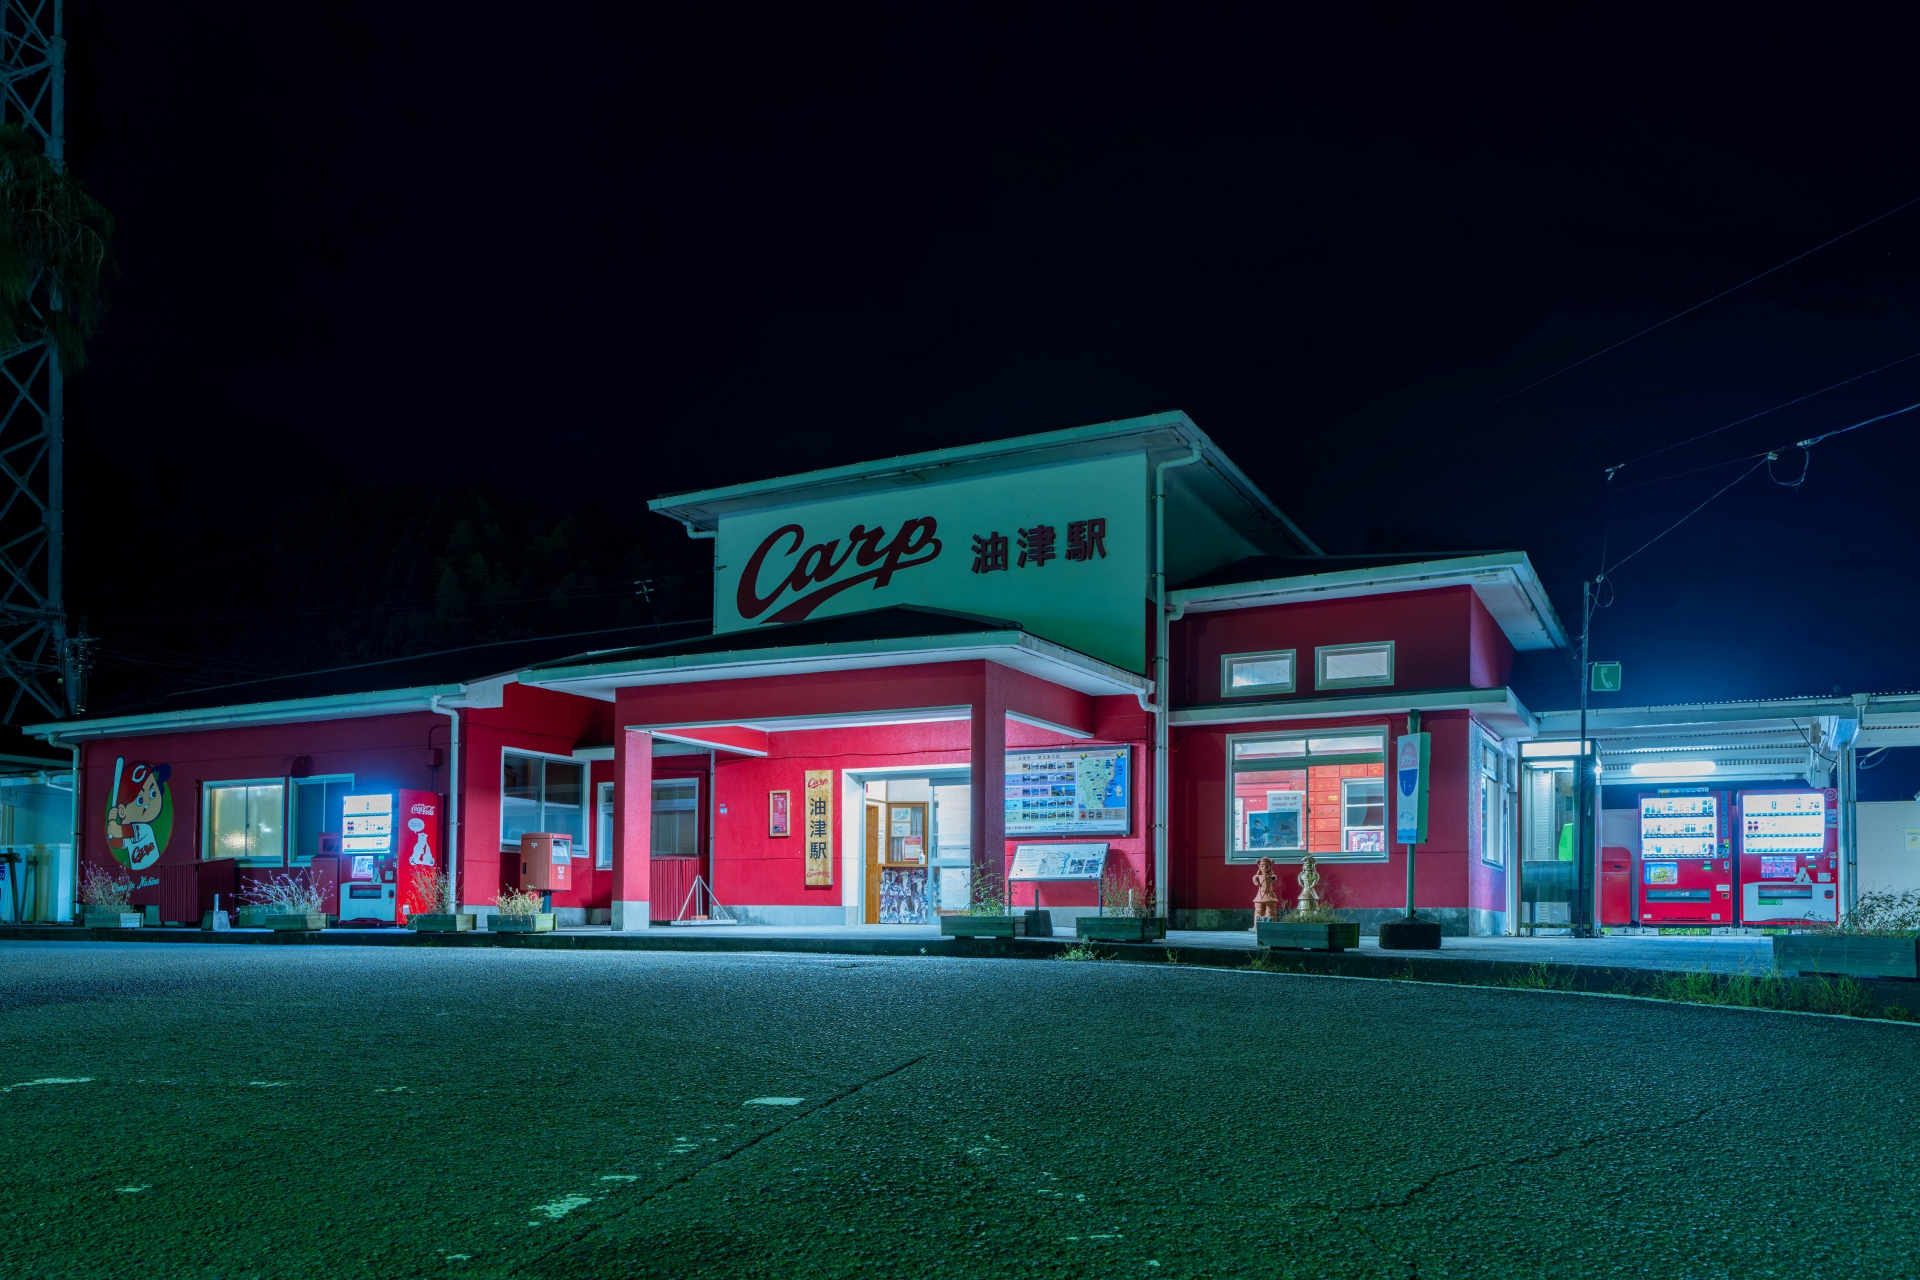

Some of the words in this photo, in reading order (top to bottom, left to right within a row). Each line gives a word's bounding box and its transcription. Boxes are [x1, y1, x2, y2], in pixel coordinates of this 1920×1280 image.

[736, 515, 943, 624] Carp
[970, 517, 1107, 575] 油津駅
[807, 777, 829, 789] Carp
[809, 797, 827, 860] 油津駅
